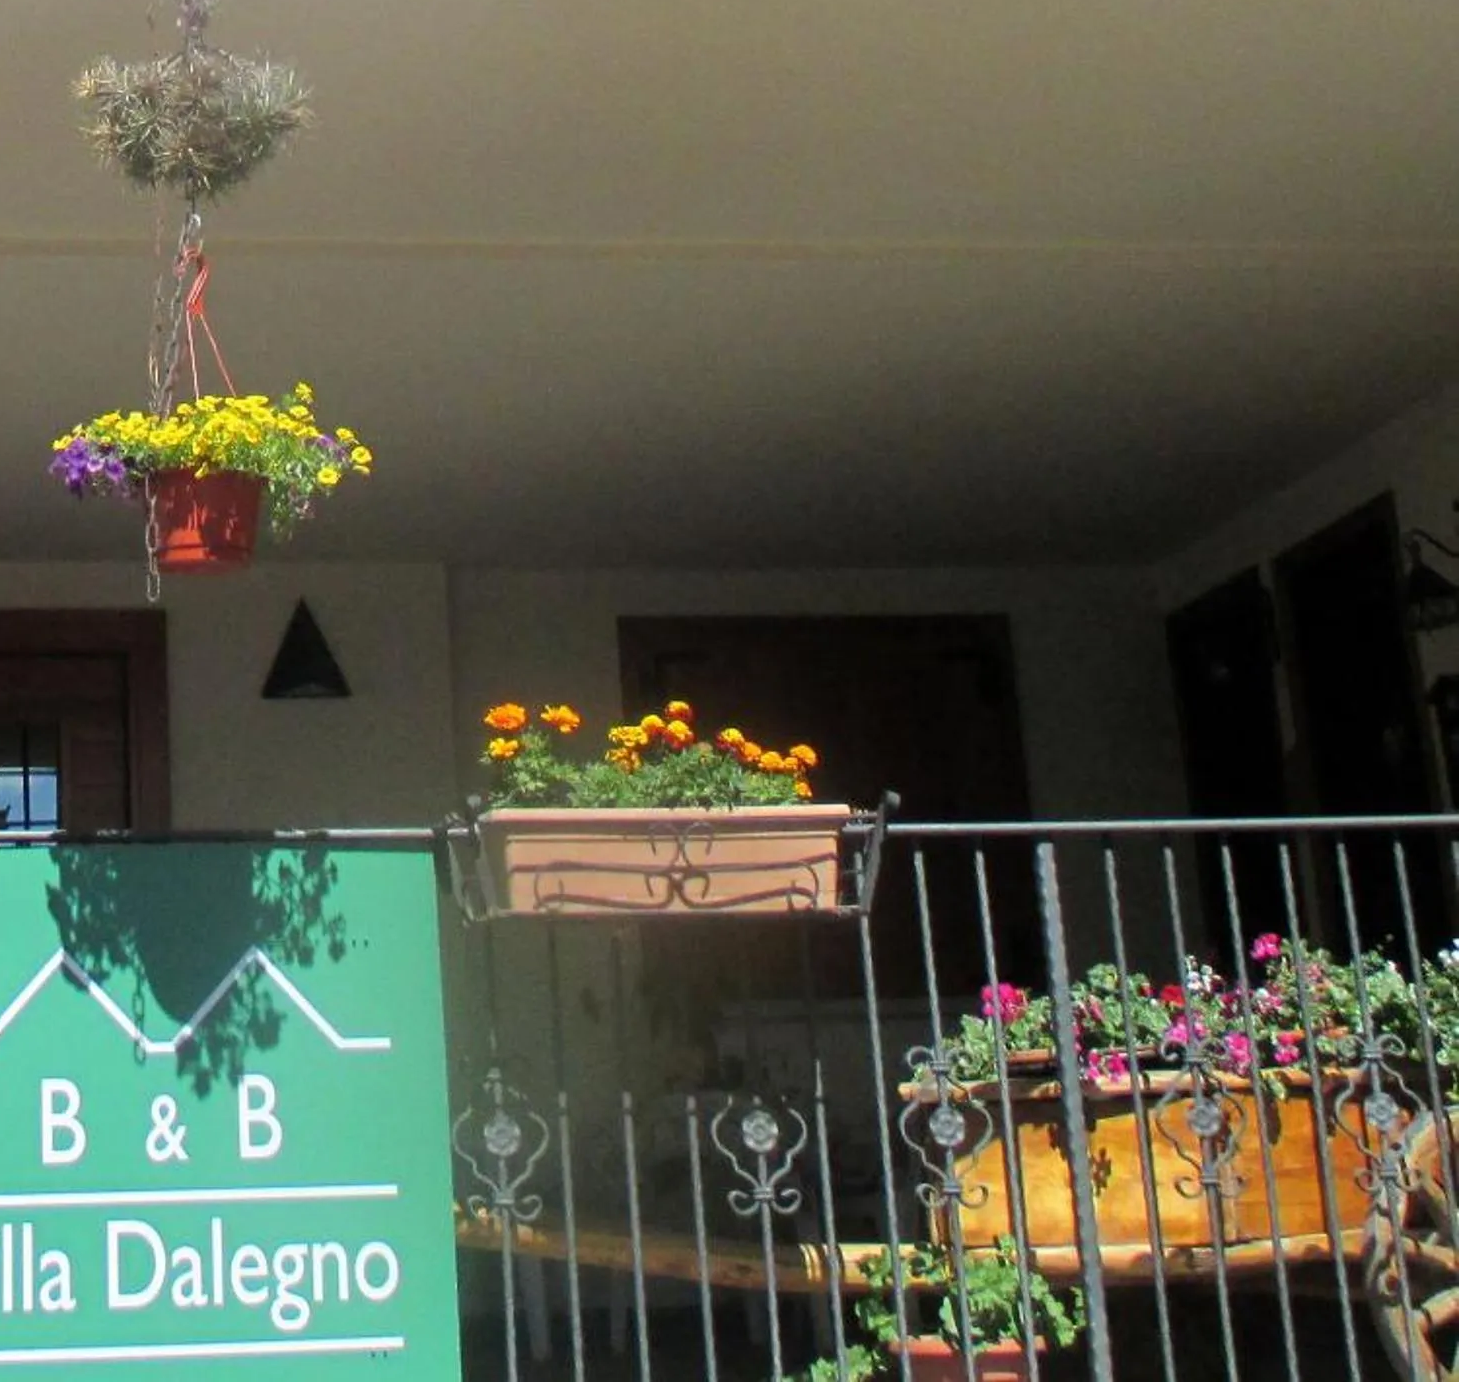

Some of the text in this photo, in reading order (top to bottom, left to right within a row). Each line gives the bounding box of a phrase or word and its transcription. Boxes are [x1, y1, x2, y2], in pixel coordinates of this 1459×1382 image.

[41, 1074, 283, 1166] B & B
[106, 1217, 400, 1334] Dalegno
